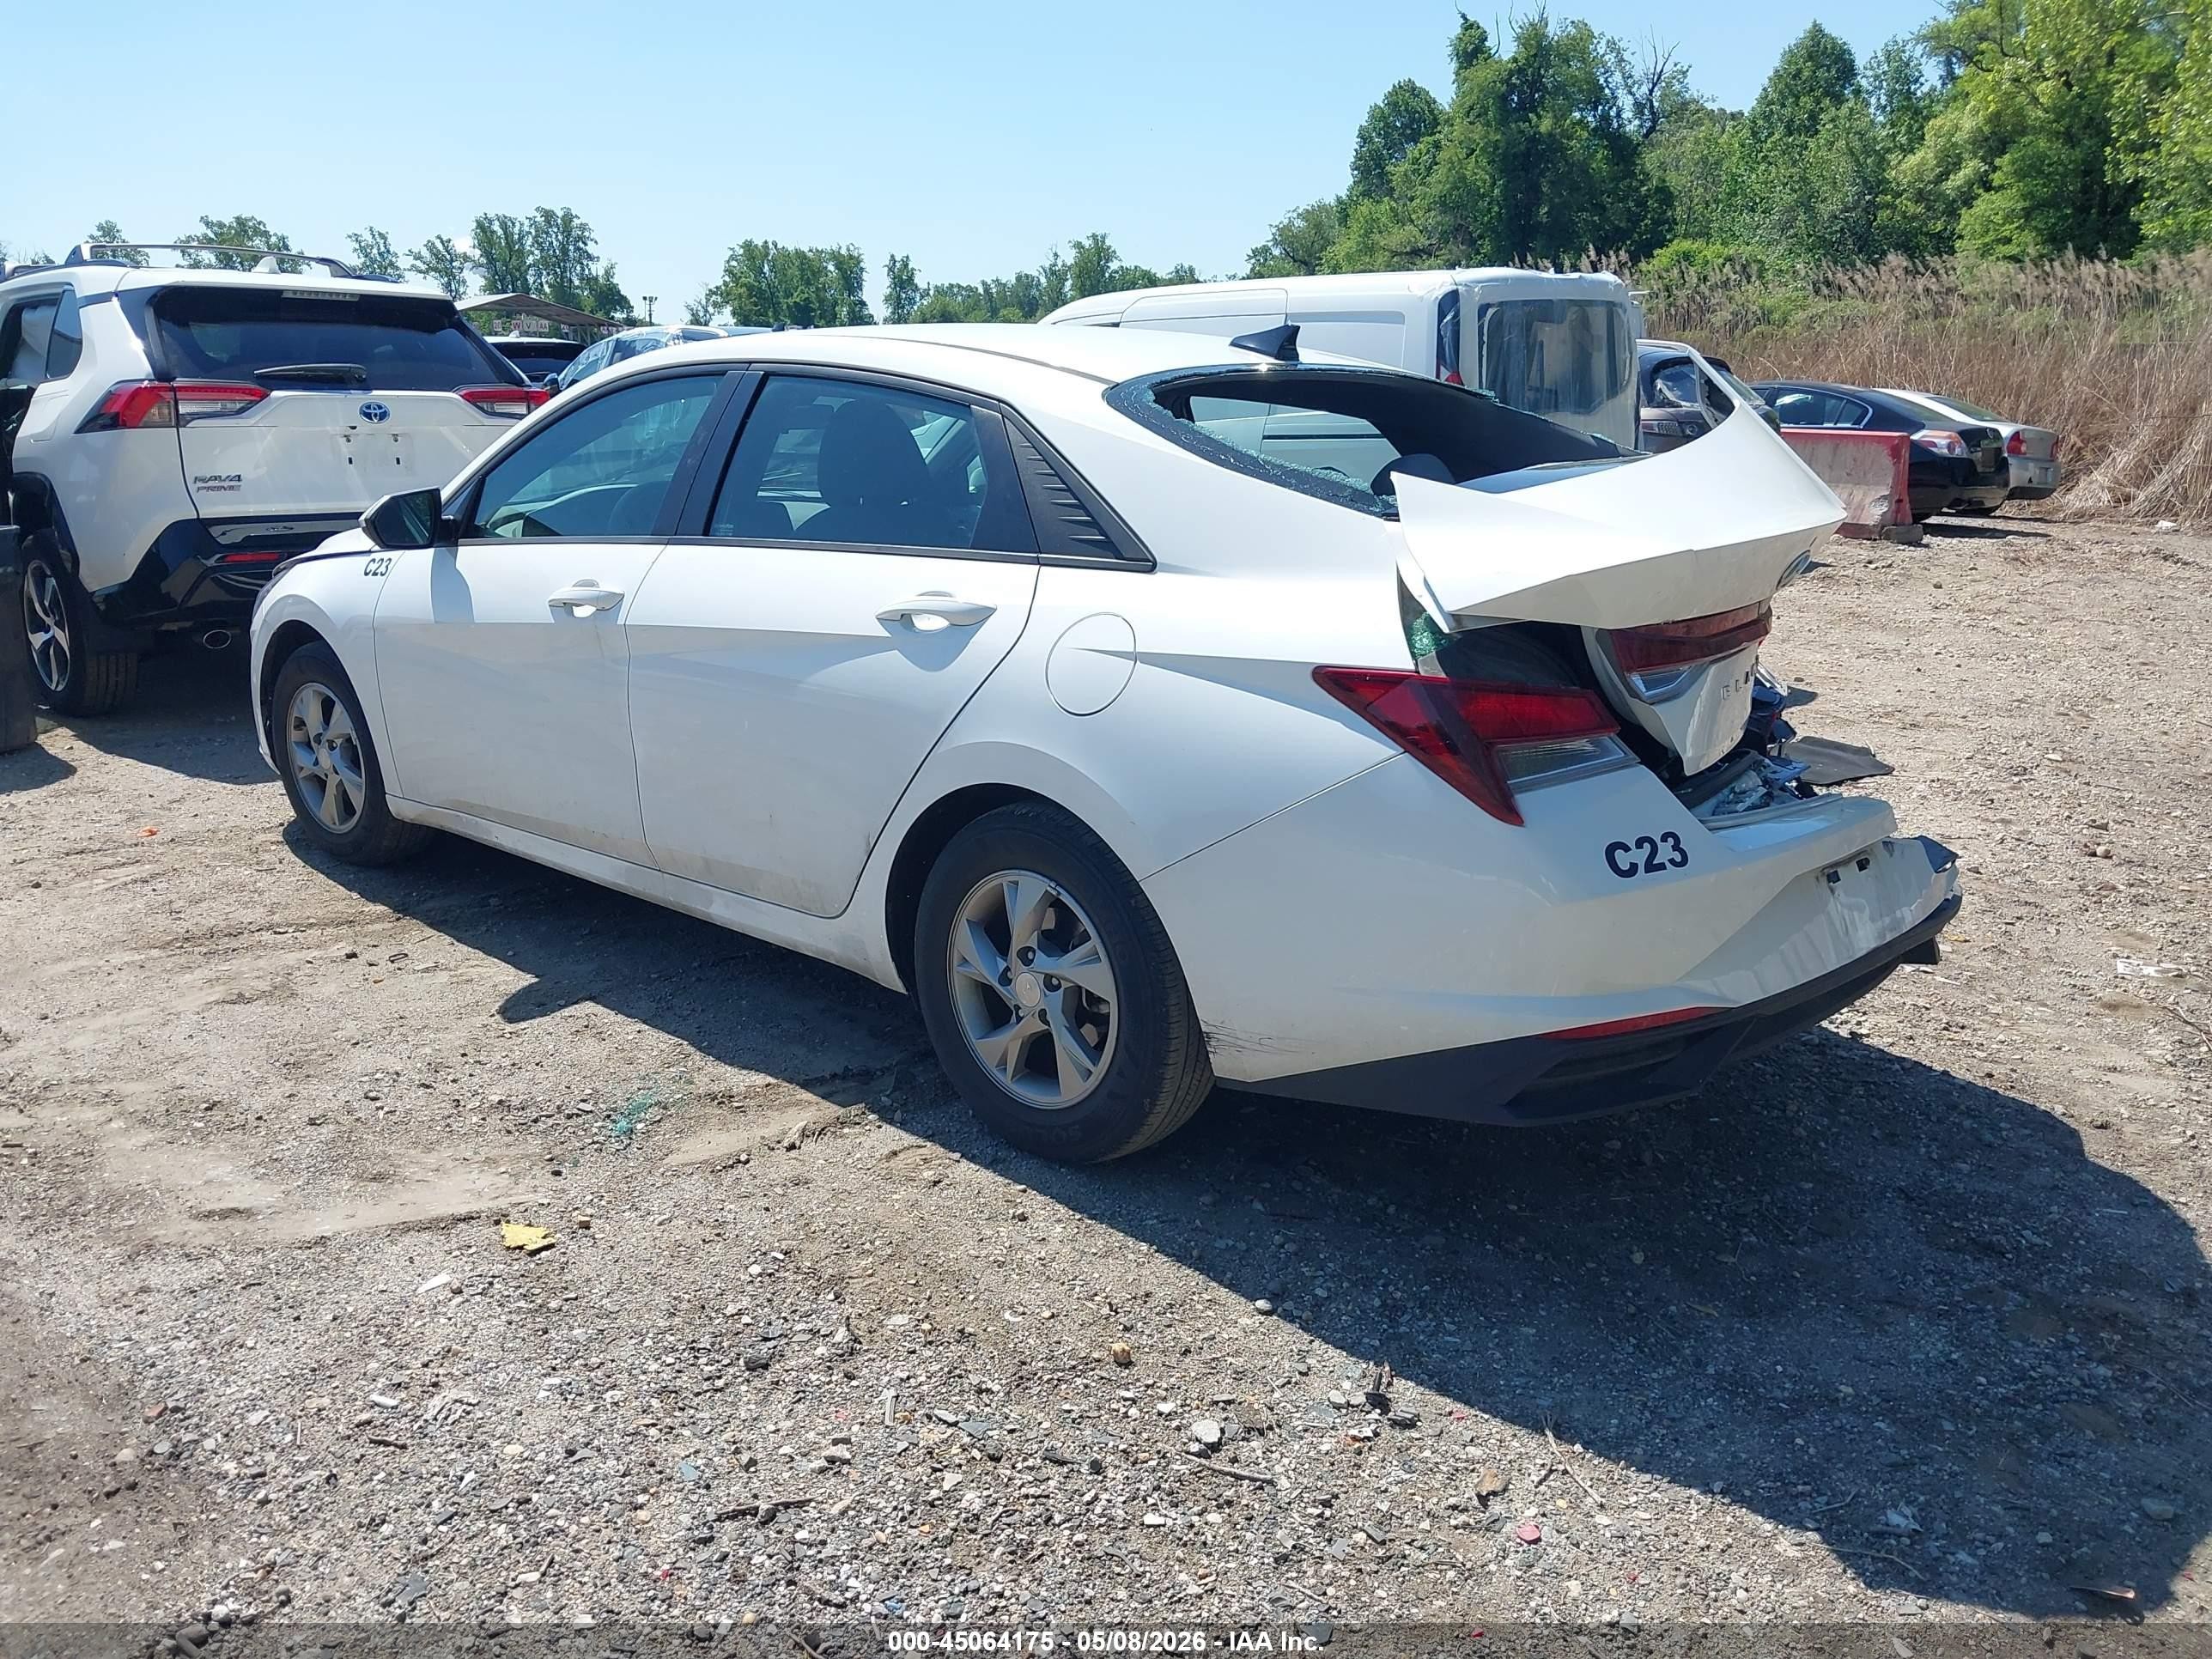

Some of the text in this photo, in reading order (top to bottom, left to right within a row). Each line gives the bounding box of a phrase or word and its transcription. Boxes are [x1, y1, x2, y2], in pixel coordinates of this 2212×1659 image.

[193, 473, 243, 485] RAV4
[197, 485, 241, 494] PRIME
[363, 557, 392, 577] C23
[1605, 831, 1689, 878] C23
